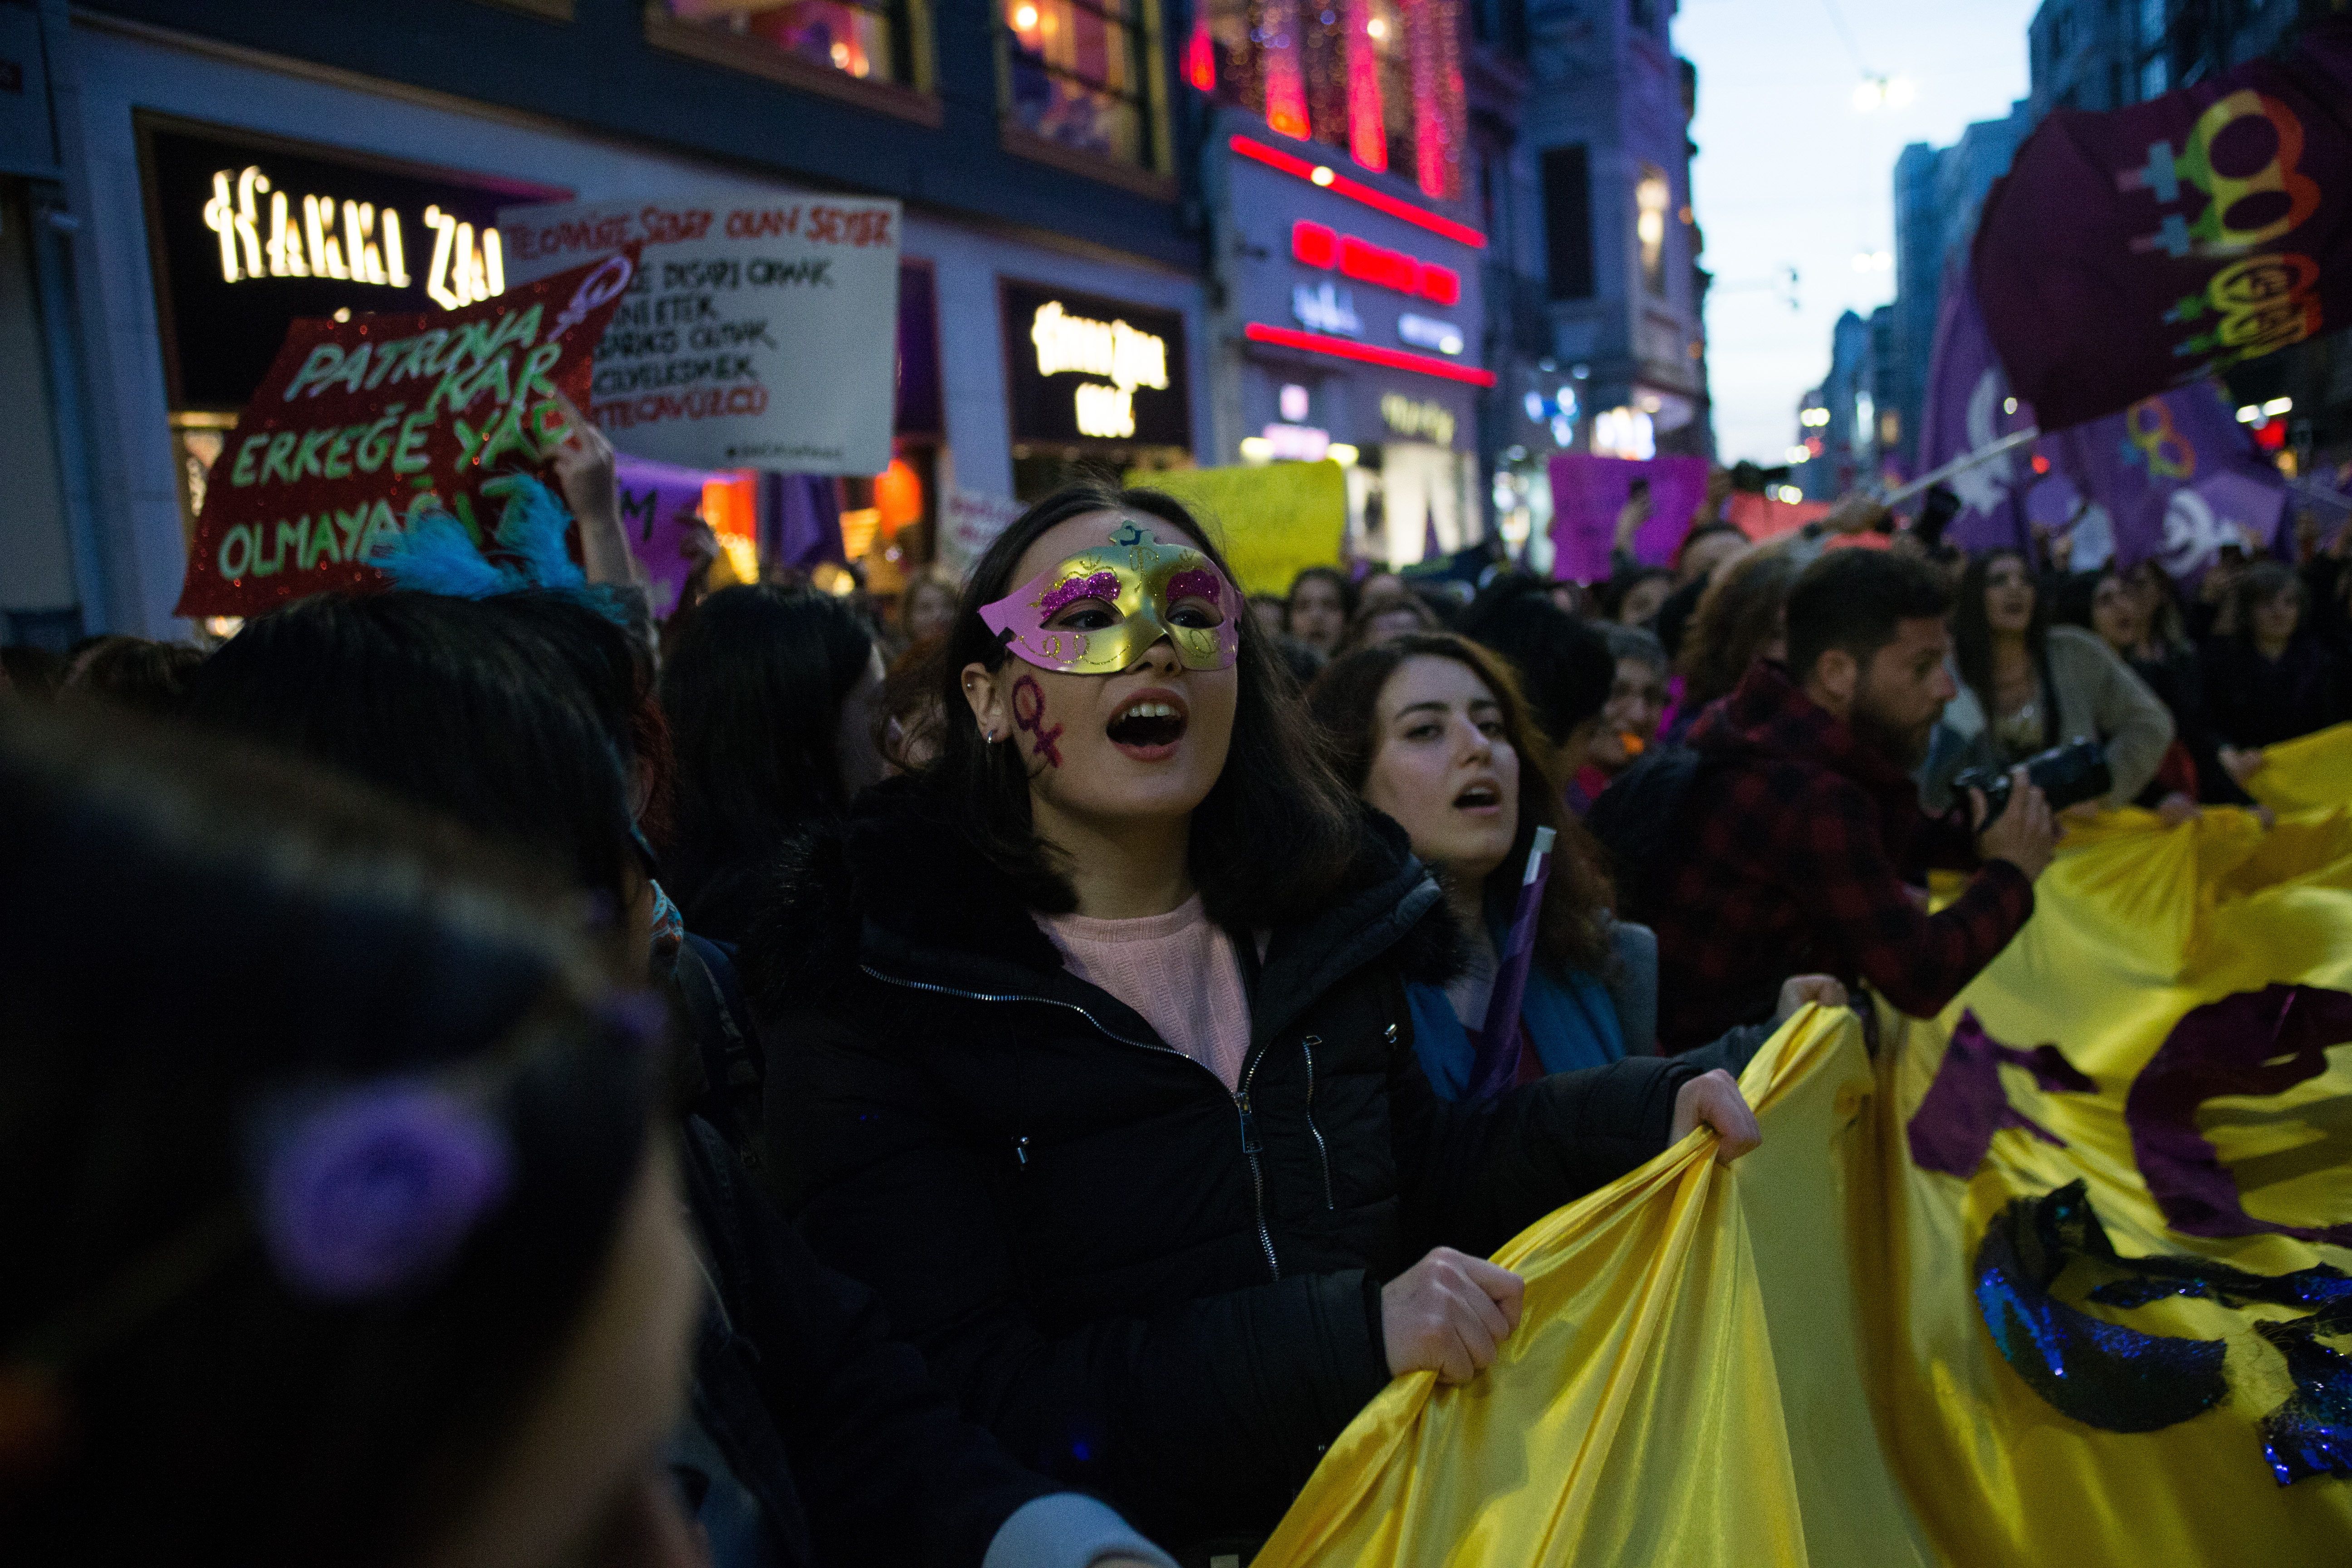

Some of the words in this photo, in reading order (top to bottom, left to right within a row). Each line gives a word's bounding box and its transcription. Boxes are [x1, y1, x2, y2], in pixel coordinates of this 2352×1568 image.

[283, 303, 544, 402] PATRONA
[425, 342, 563, 412] KAR
[230, 402, 438, 488] ERKEĞE
